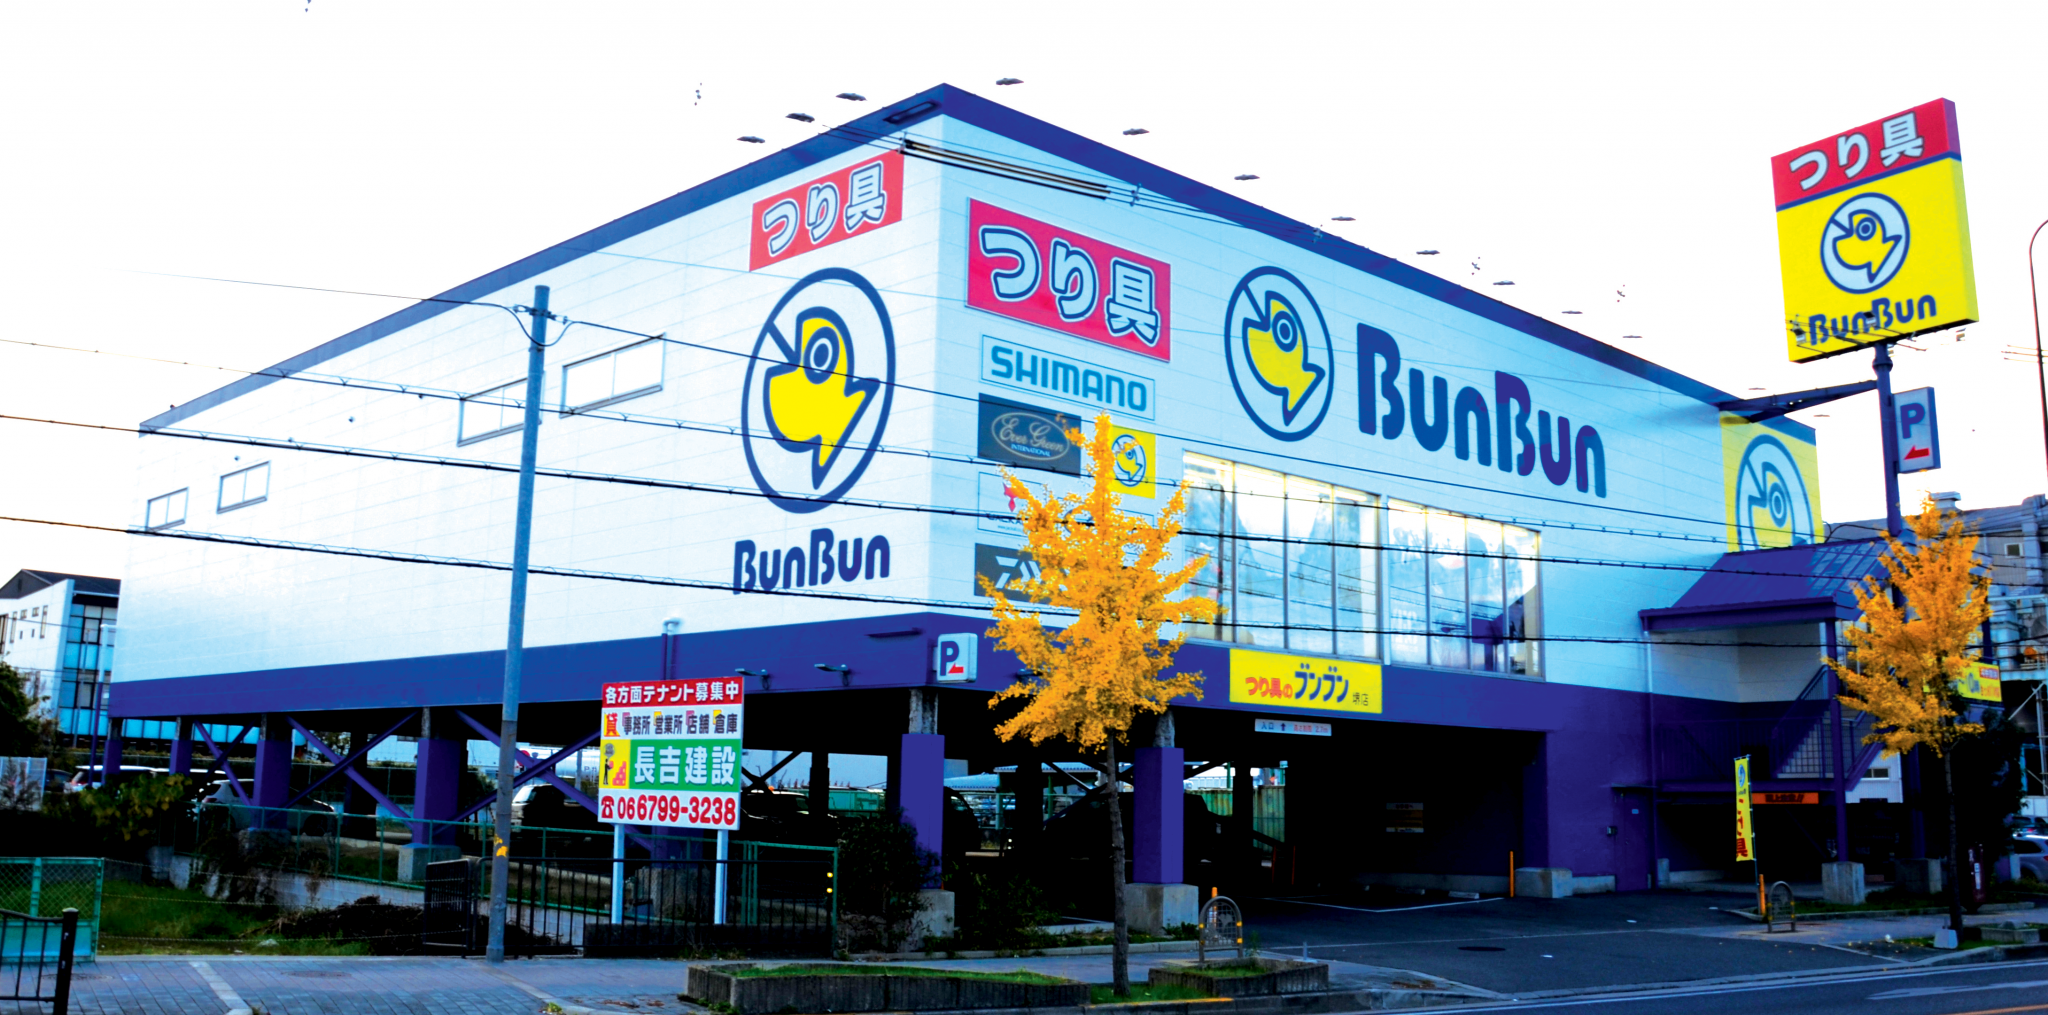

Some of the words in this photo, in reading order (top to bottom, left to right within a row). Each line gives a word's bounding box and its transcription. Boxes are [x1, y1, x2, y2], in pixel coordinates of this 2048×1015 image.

[1789, 111, 1924, 191] つり具
[762, 160, 887, 256] つり具
[979, 224, 1160, 347] つり具
[991, 345, 1147, 412] SHIMANO
[1356, 322, 1607, 499] BunBun
[1900, 402, 1926, 439] P
[732, 527, 891, 595] BunBun
[940, 640, 960, 676] P
[605, 681, 739, 704] 各方面テナント募集中
[634, 745, 737, 786] 長吉建設
